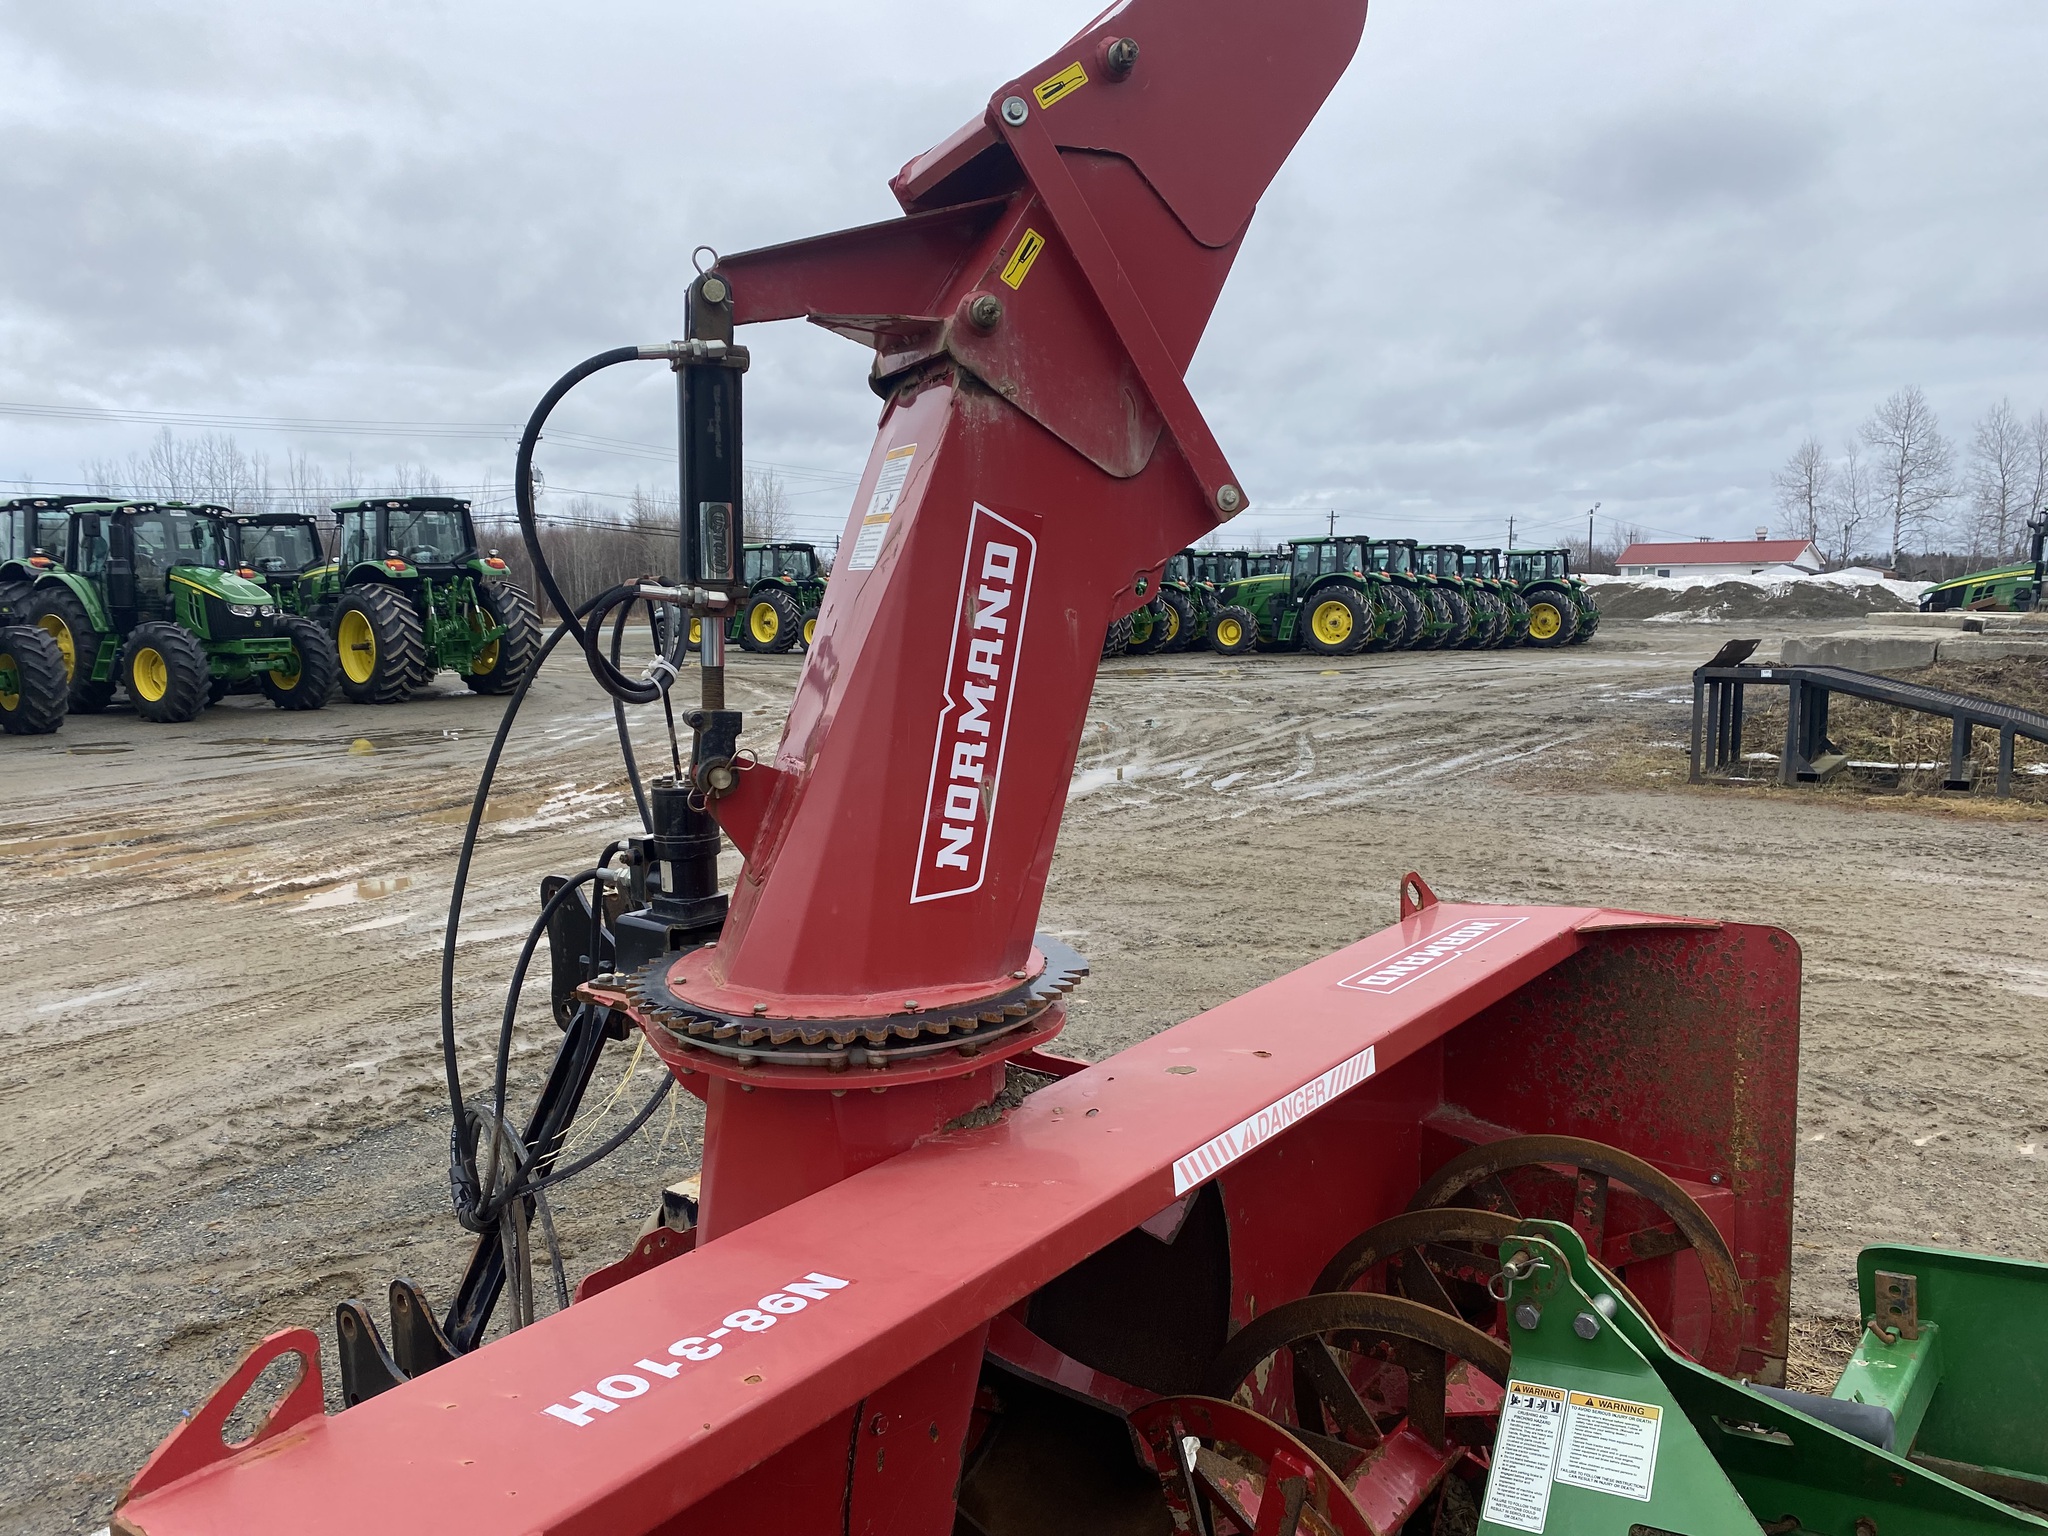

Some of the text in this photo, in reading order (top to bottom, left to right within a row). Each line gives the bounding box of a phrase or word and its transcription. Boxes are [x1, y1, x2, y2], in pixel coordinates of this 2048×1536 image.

[936, 541, 1018, 872] NORMAND
[1357, 920, 1501, 987] NORMAND
[1257, 1078, 1326, 1142] DANGER
[542, 1272, 851, 1427] N98-310H
[1521, 1386, 1560, 1398] WARNING
[1597, 1399, 1644, 1415] WARNING
